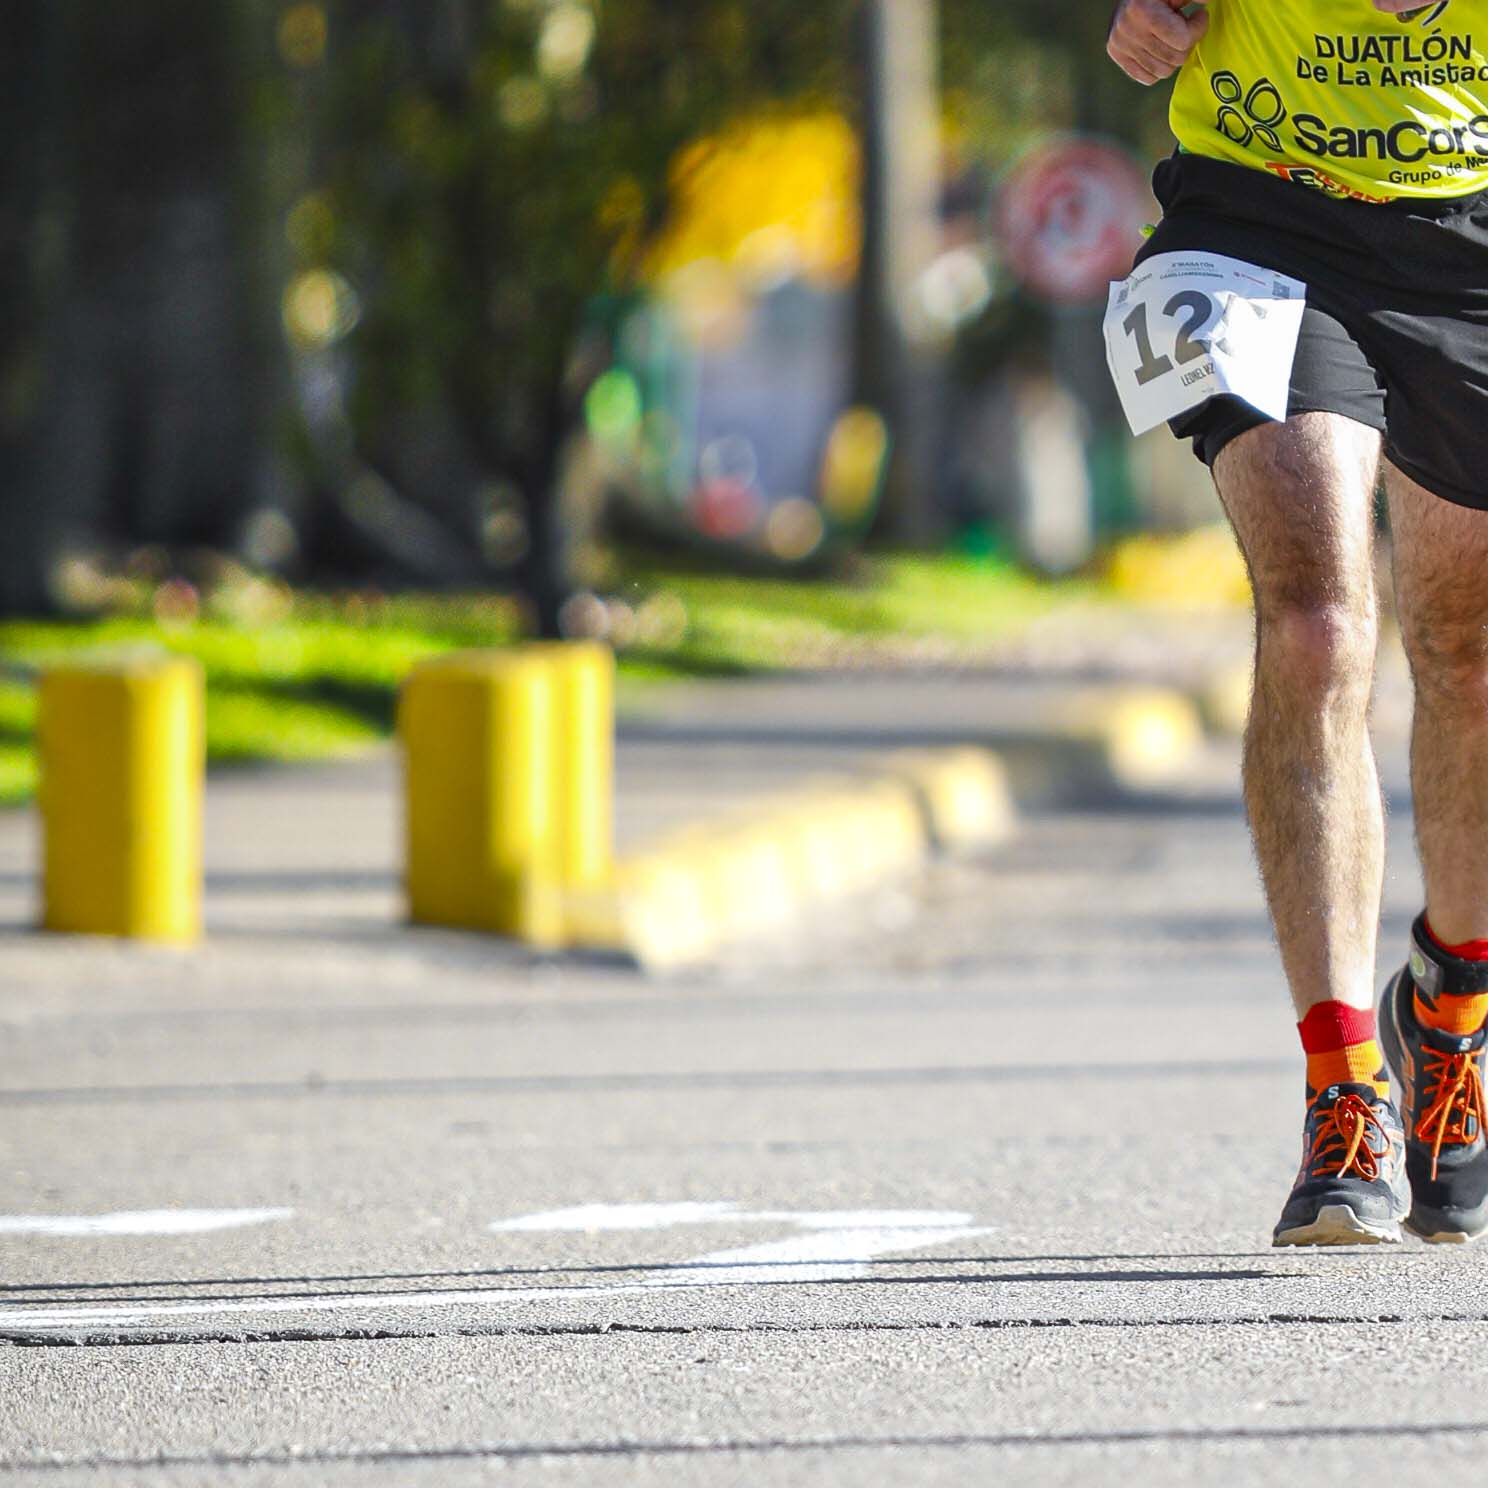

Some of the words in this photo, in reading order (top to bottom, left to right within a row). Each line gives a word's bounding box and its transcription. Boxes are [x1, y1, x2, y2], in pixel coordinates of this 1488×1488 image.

[1314, 27, 1472, 64] DUATLÓN
[1296, 56, 1329, 84] De
[1337, 62, 1371, 86] La
[1388, 170, 1442, 185] Grupo
[1446, 161, 1462, 177] de
[1327, 1085, 1340, 1100] S
